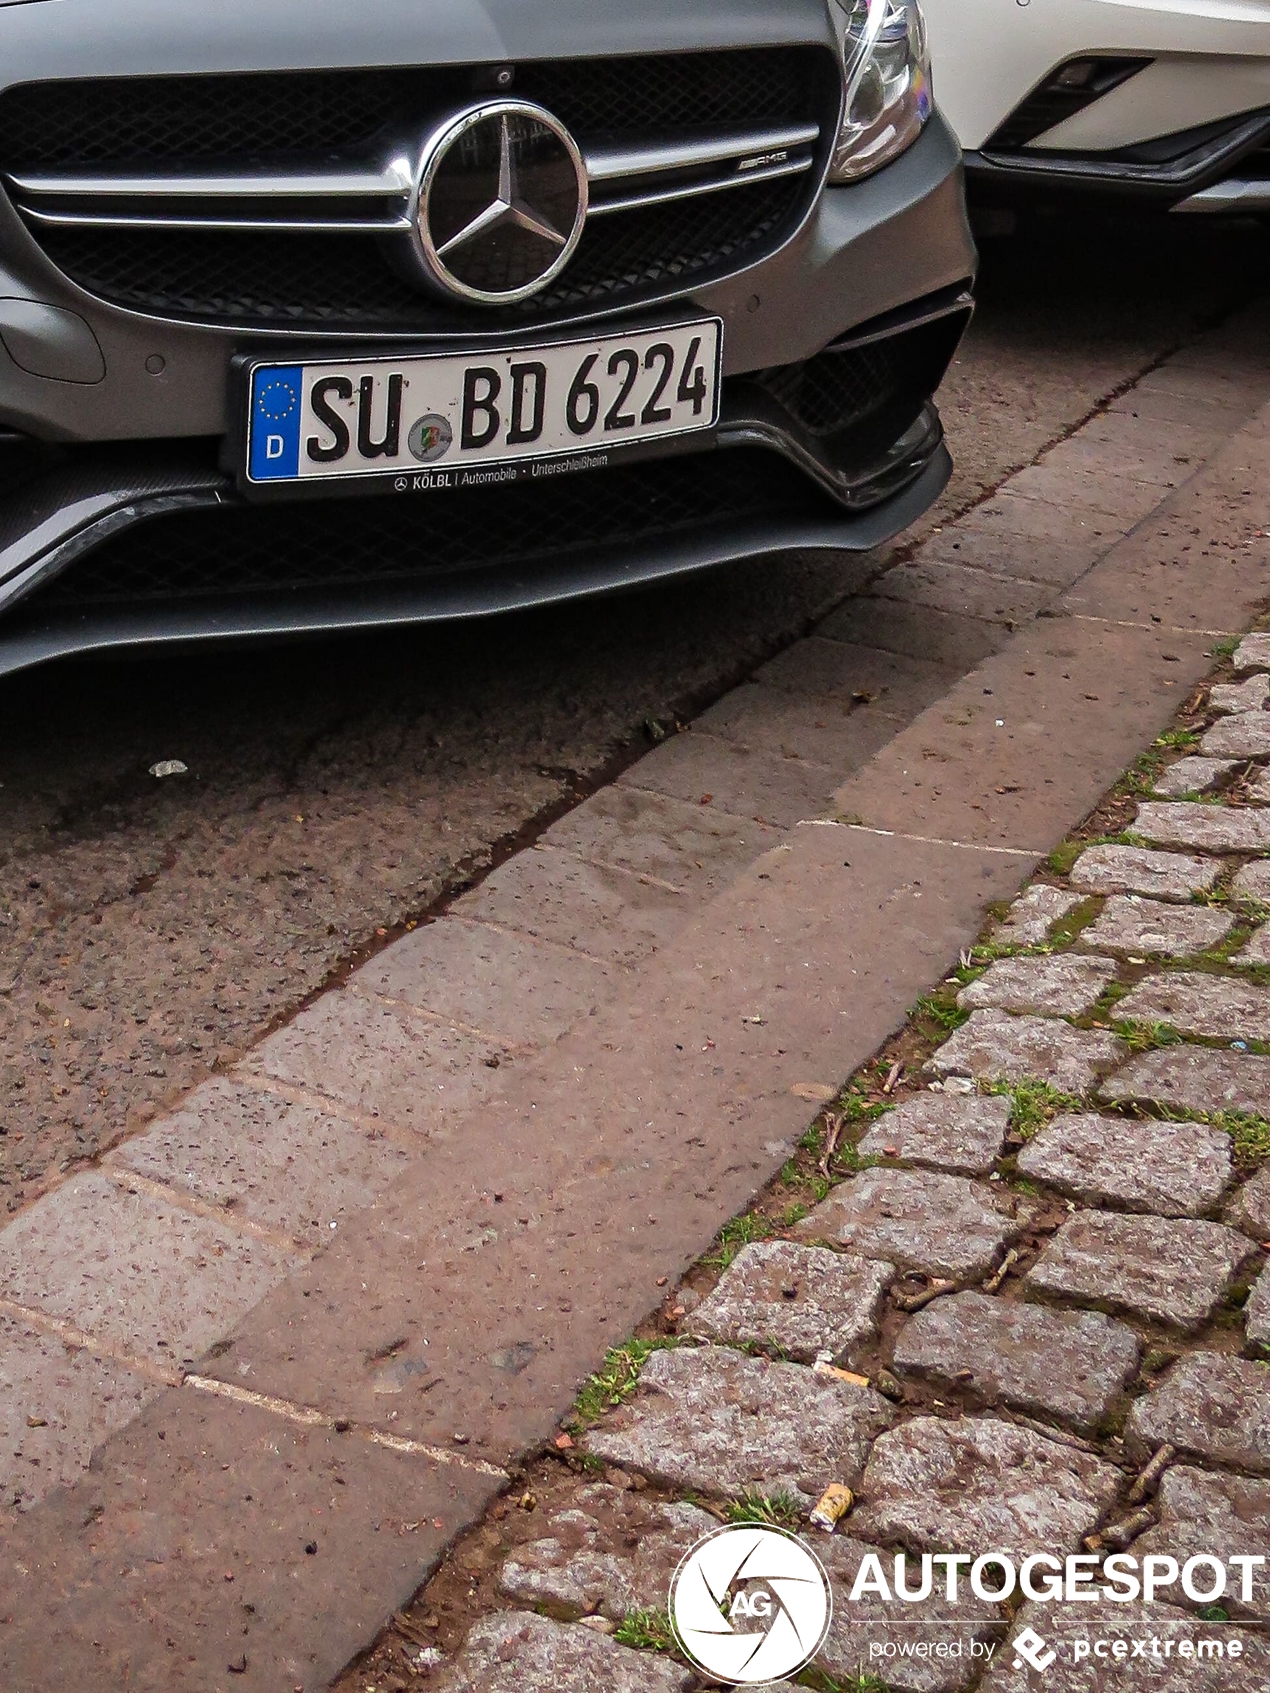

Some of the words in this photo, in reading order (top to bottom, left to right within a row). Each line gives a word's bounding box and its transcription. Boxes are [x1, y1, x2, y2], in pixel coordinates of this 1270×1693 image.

[306, 373, 403, 463] SU
[460, 361, 547, 451] BD
[566, 337, 707, 436] 6224
[265, 434, 284, 459] D
[412, 473, 452, 490] KÖLBL
[461, 466, 517, 486] Automobile
